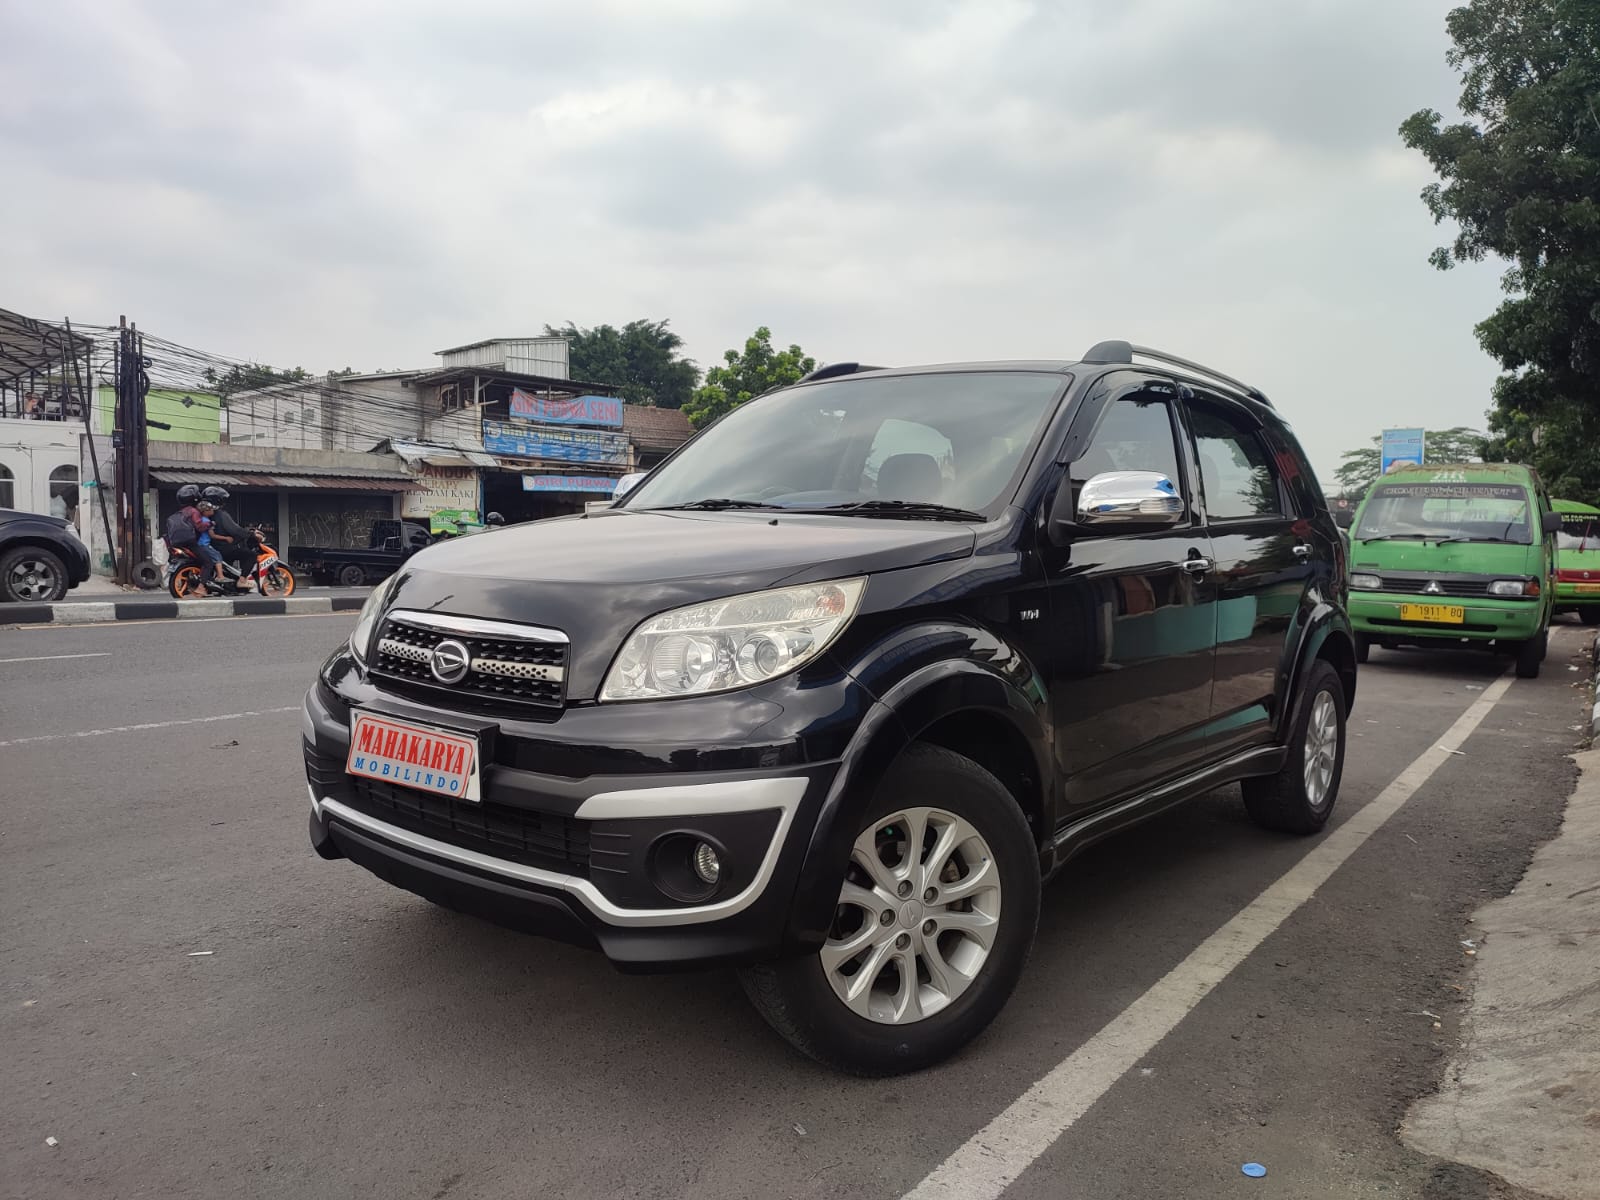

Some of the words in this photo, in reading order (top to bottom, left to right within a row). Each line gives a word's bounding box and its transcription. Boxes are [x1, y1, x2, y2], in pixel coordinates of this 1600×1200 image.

[513, 391, 540, 413] GIRI
[590, 401, 619, 420] SENI
[535, 477, 563, 487] GIRI
[567, 477, 612, 488] PURWA
[451, 489, 474, 499] KAKI
[1420, 606, 1440, 617] 1911
[357, 723, 465, 775] MAHAKARYA
[354, 756, 459, 791] MOBILINDO
